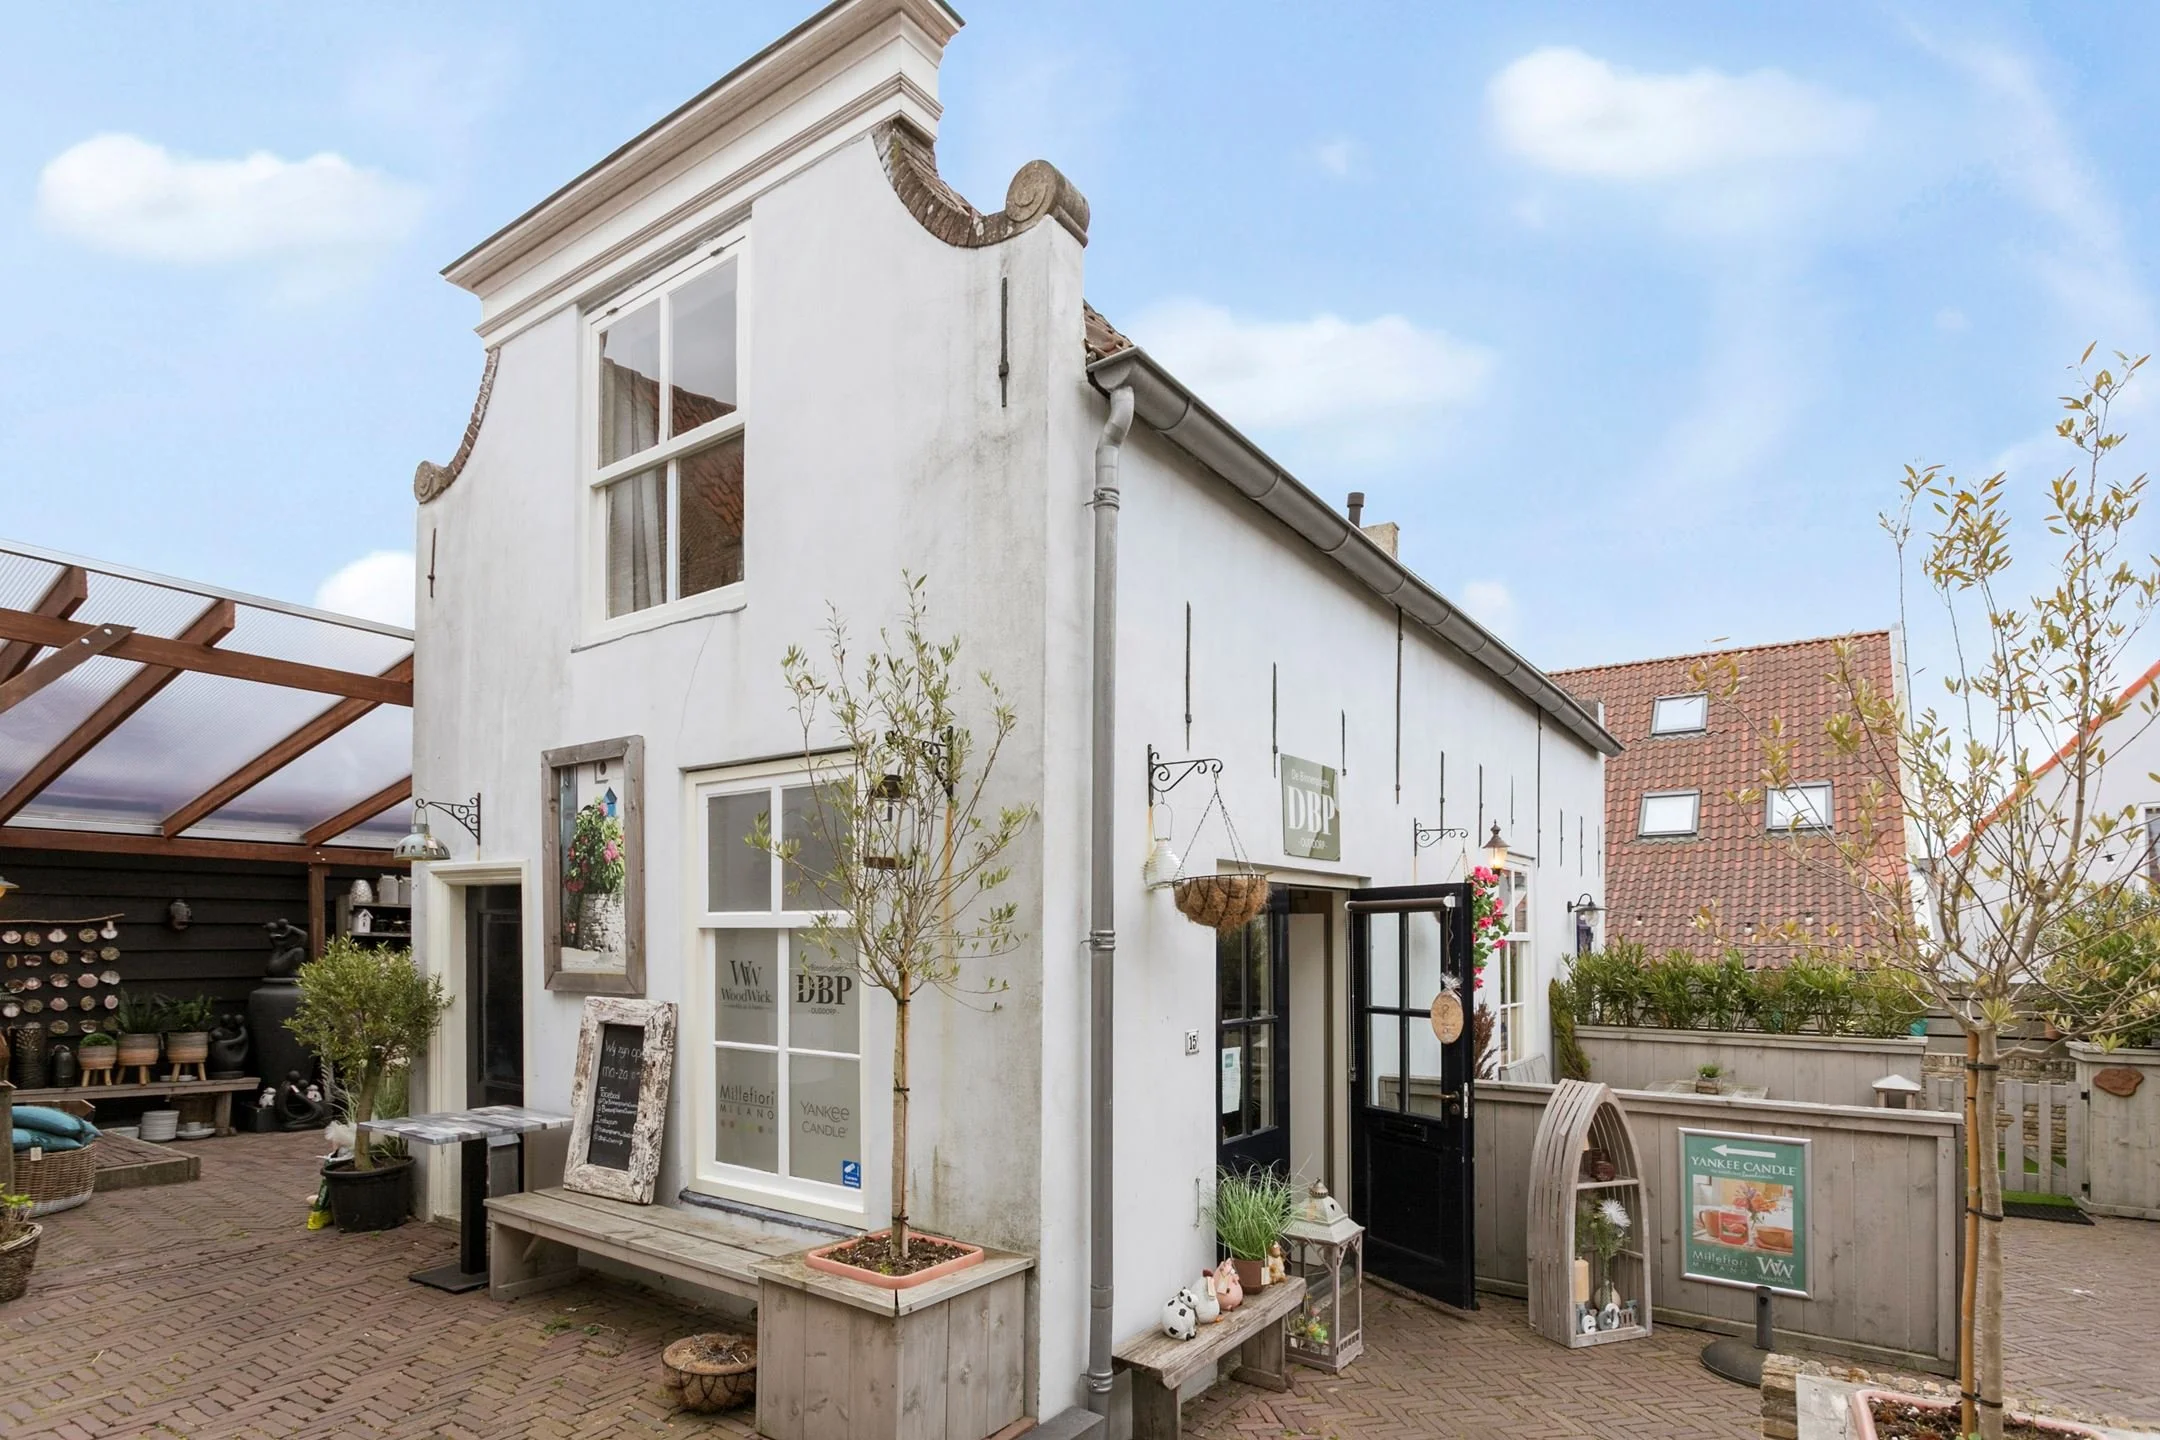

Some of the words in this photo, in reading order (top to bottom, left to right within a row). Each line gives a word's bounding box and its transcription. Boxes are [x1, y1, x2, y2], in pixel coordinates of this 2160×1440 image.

[1287, 785, 1336, 836] DBP
[795, 974, 853, 1006] DBP
[1189, 1035, 1197, 1050] 15
[719, 1085, 775, 1106] Millefiori
[719, 1103, 775, 1120] MILANO
[1690, 1156, 1741, 1171] YANKEE
[1743, 1161, 1797, 1177] CANDLE
[1692, 1250, 1748, 1267] Millefiori
